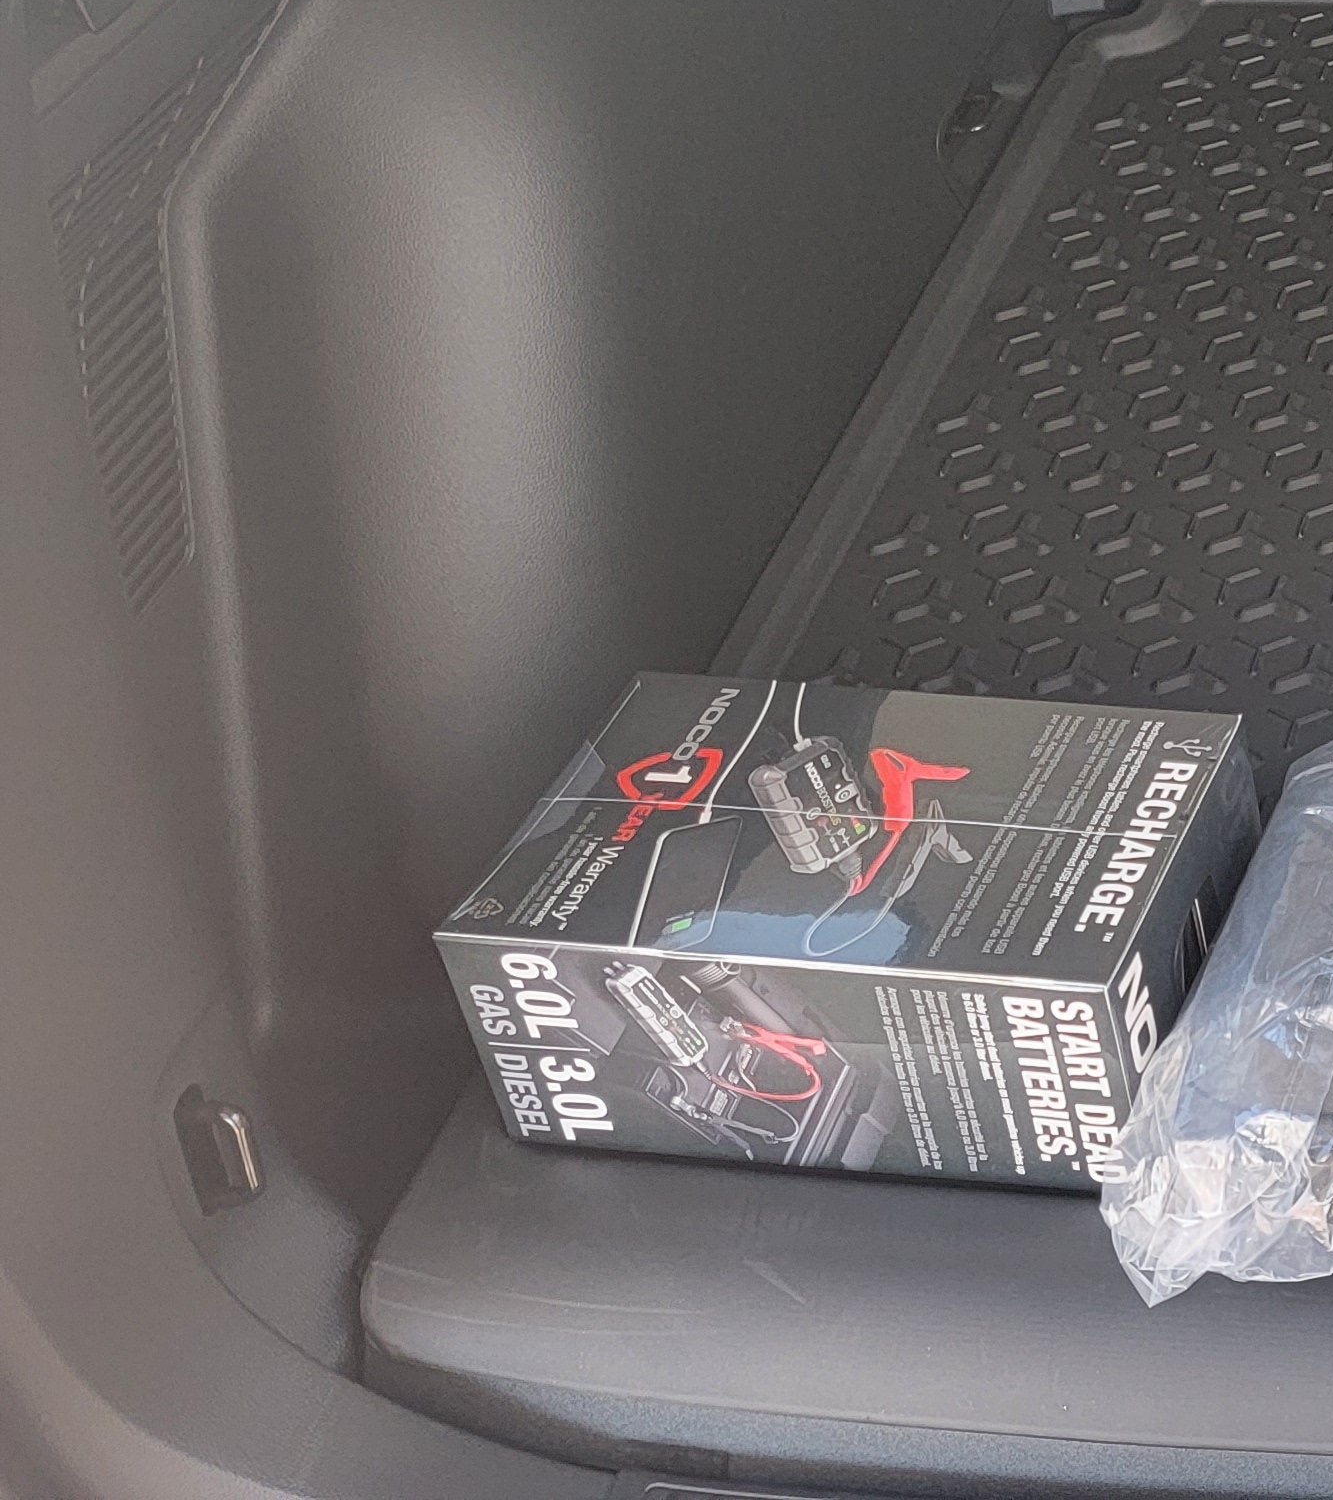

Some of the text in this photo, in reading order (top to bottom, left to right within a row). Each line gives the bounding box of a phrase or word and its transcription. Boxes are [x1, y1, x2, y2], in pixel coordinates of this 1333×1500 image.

[672, 688, 740, 760] NOCO
[1137, 720, 1153, 731] the
[1127, 731, 1147, 748] most.
[1139, 720, 1165, 750] Recharge
[1119, 748, 1138, 764] Plus,
[645, 766, 692, 783] 1
[803, 761, 823, 790] NOCO
[1104, 763, 1130, 791] recharge
[1117, 750, 1150, 790] smartphones,
[1095, 791, 1115, 809] Boost
[1105, 790, 1128, 813] tablets,
[1086, 809, 1105, 825] from
[1097, 813, 1116, 827] and
[578, 841, 600, 856] year
[1064, 837, 1090, 866] powered
[1080, 844, 1100, 859] USB
[979, 868, 998, 884] USB
[1055, 867, 1075, 882] USB
[1067, 859, 1092, 884] devices
[1046, 882, 1067, 898] port.
[1056, 885, 1078, 904] when
[1049, 904, 1068, 917] you
[1039, 918, 1061, 936] need
[990, 938, 1011, 955] USB
[1029, 936, 1051, 956] them
[501, 953, 585, 1039] 6.0L
[962, 1000, 976, 1012] 6.0
[971, 1036, 985, 1048] 3.0
[470, 985, 550, 1136] GAS DIESEL
[540, 1056, 613, 1140] 3.0L
[897, 1079, 911, 1092] 6.0
[906, 1112, 920, 1124] 3.0
[1051, 1000, 1132, 1187] START DEAD
[1013, 1164, 1027, 1175] up
